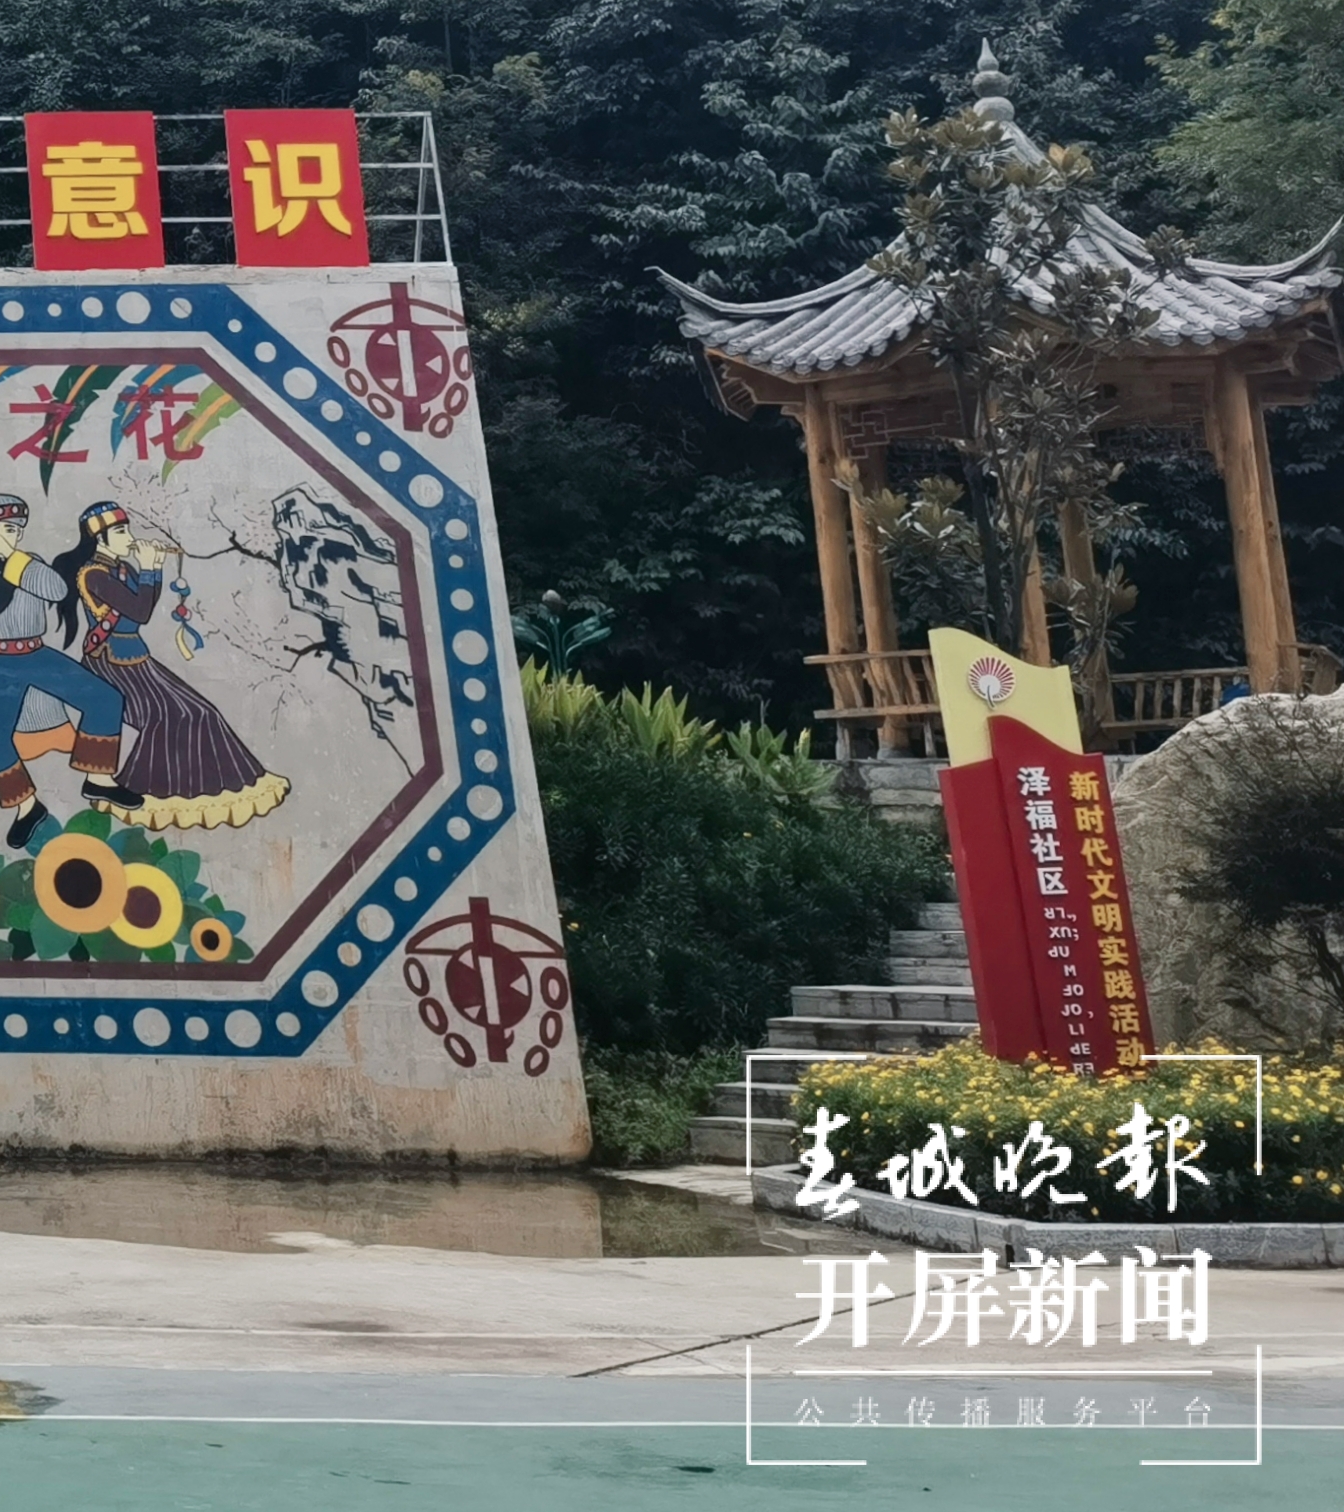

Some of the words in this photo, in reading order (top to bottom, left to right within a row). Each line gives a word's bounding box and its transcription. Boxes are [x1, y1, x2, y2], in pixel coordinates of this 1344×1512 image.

[1016, 766, 1068, 896] 泽福社区
[1068, 770, 1149, 1068] 新时代文明实践活动
